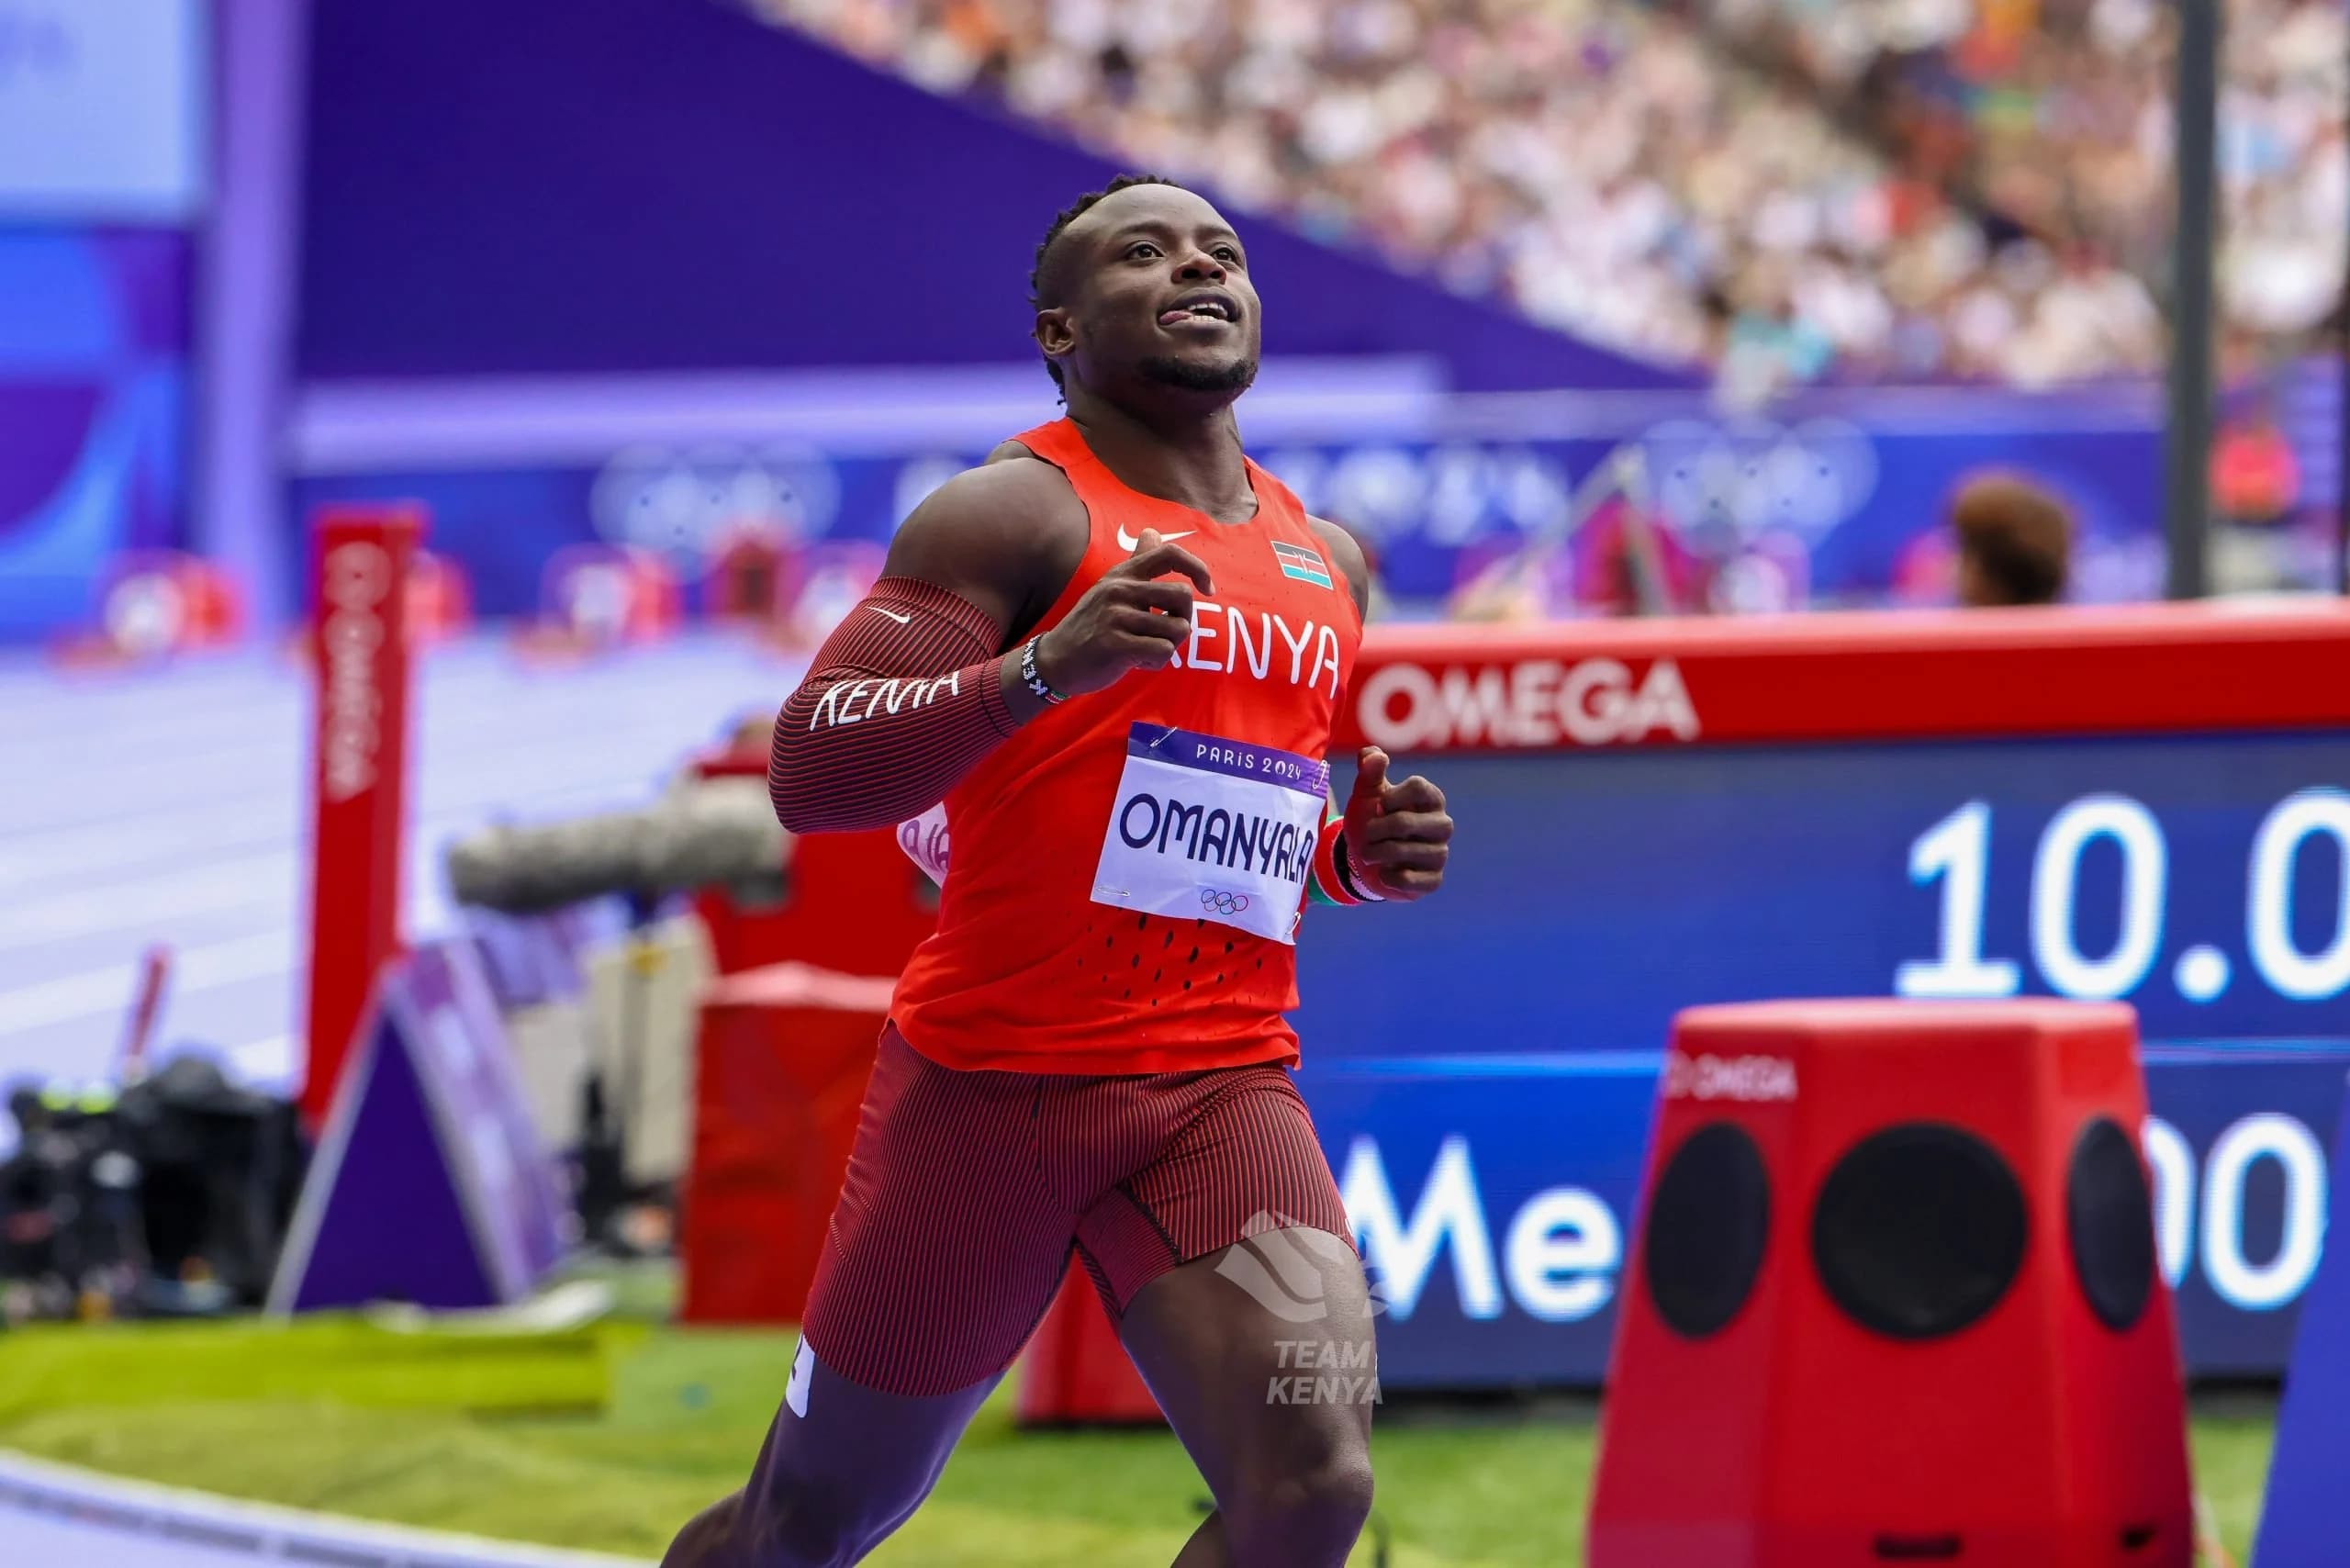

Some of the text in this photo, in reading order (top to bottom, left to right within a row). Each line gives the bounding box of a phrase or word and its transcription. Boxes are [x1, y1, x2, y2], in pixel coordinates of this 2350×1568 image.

[1169, 600, 1339, 700] ENYA
[1357, 655, 1700, 753] OMEGA
[1261, 757, 1301, 780] 2024
[1119, 793, 1314, 885] OMANYALA
